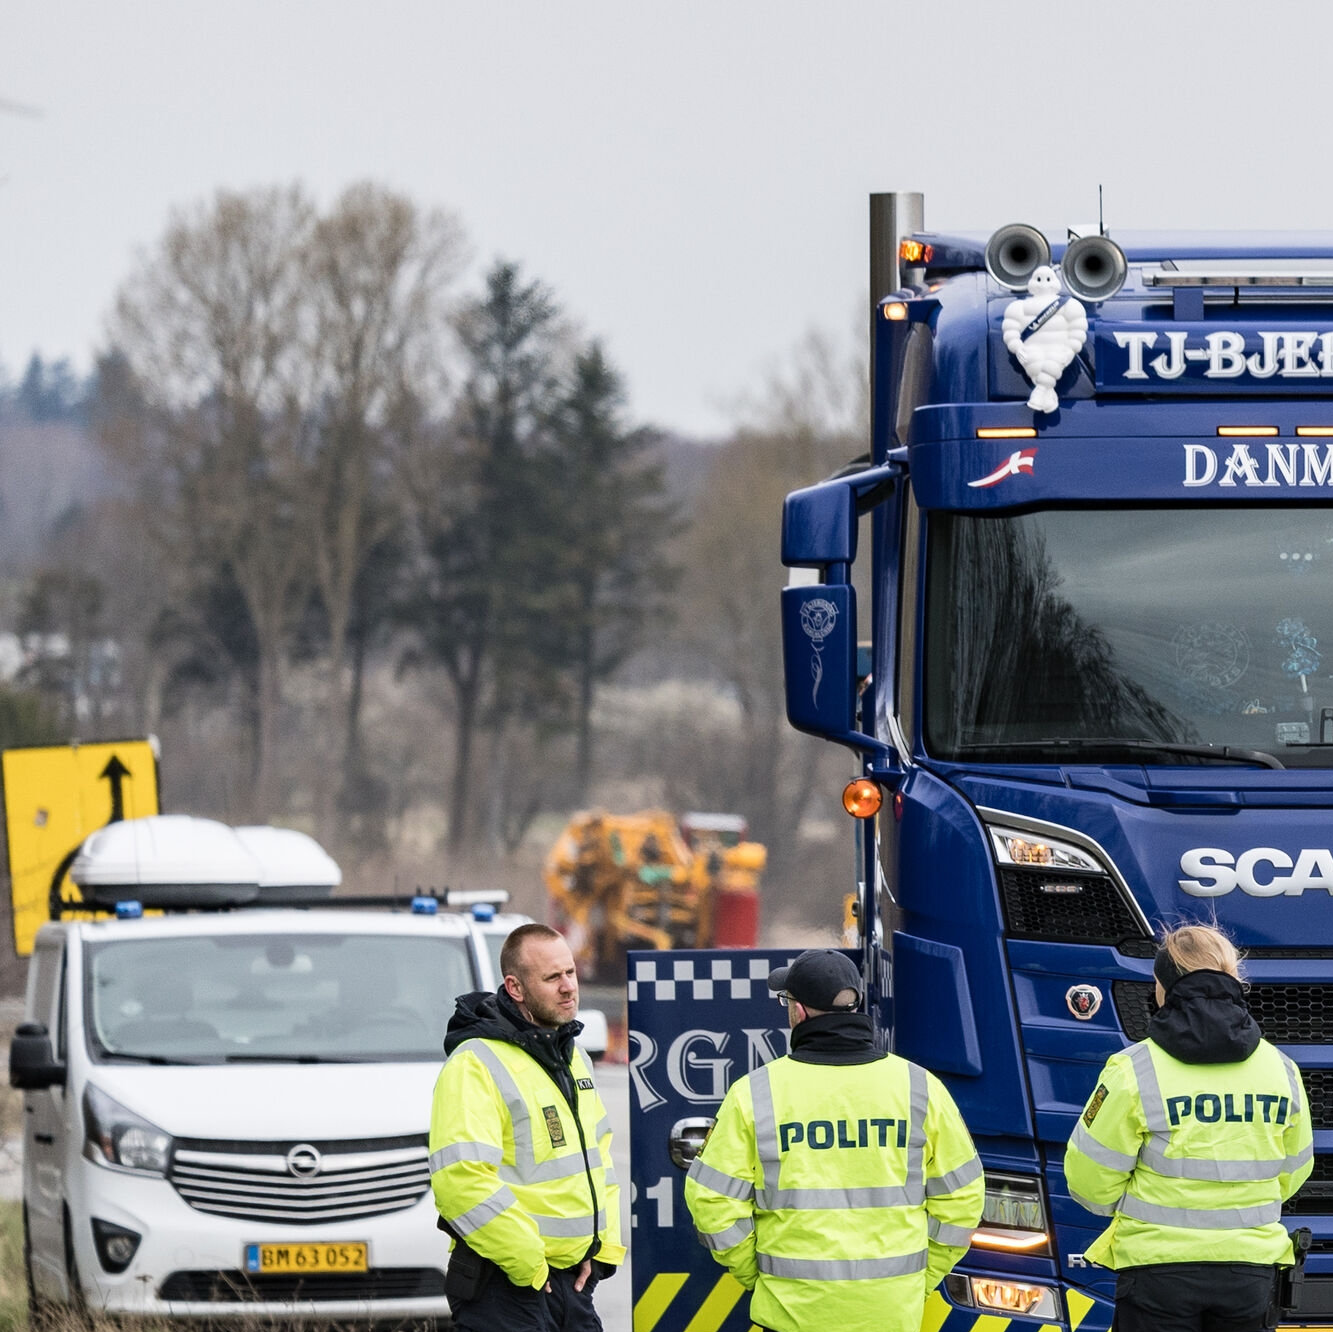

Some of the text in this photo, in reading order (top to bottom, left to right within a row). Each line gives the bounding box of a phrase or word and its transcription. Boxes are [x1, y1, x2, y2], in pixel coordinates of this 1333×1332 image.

[1166, 1093, 1289, 1126] POLITI
[779, 1118, 907, 1152] POLITI
[262, 1247, 363, 1268] BM 63 052
